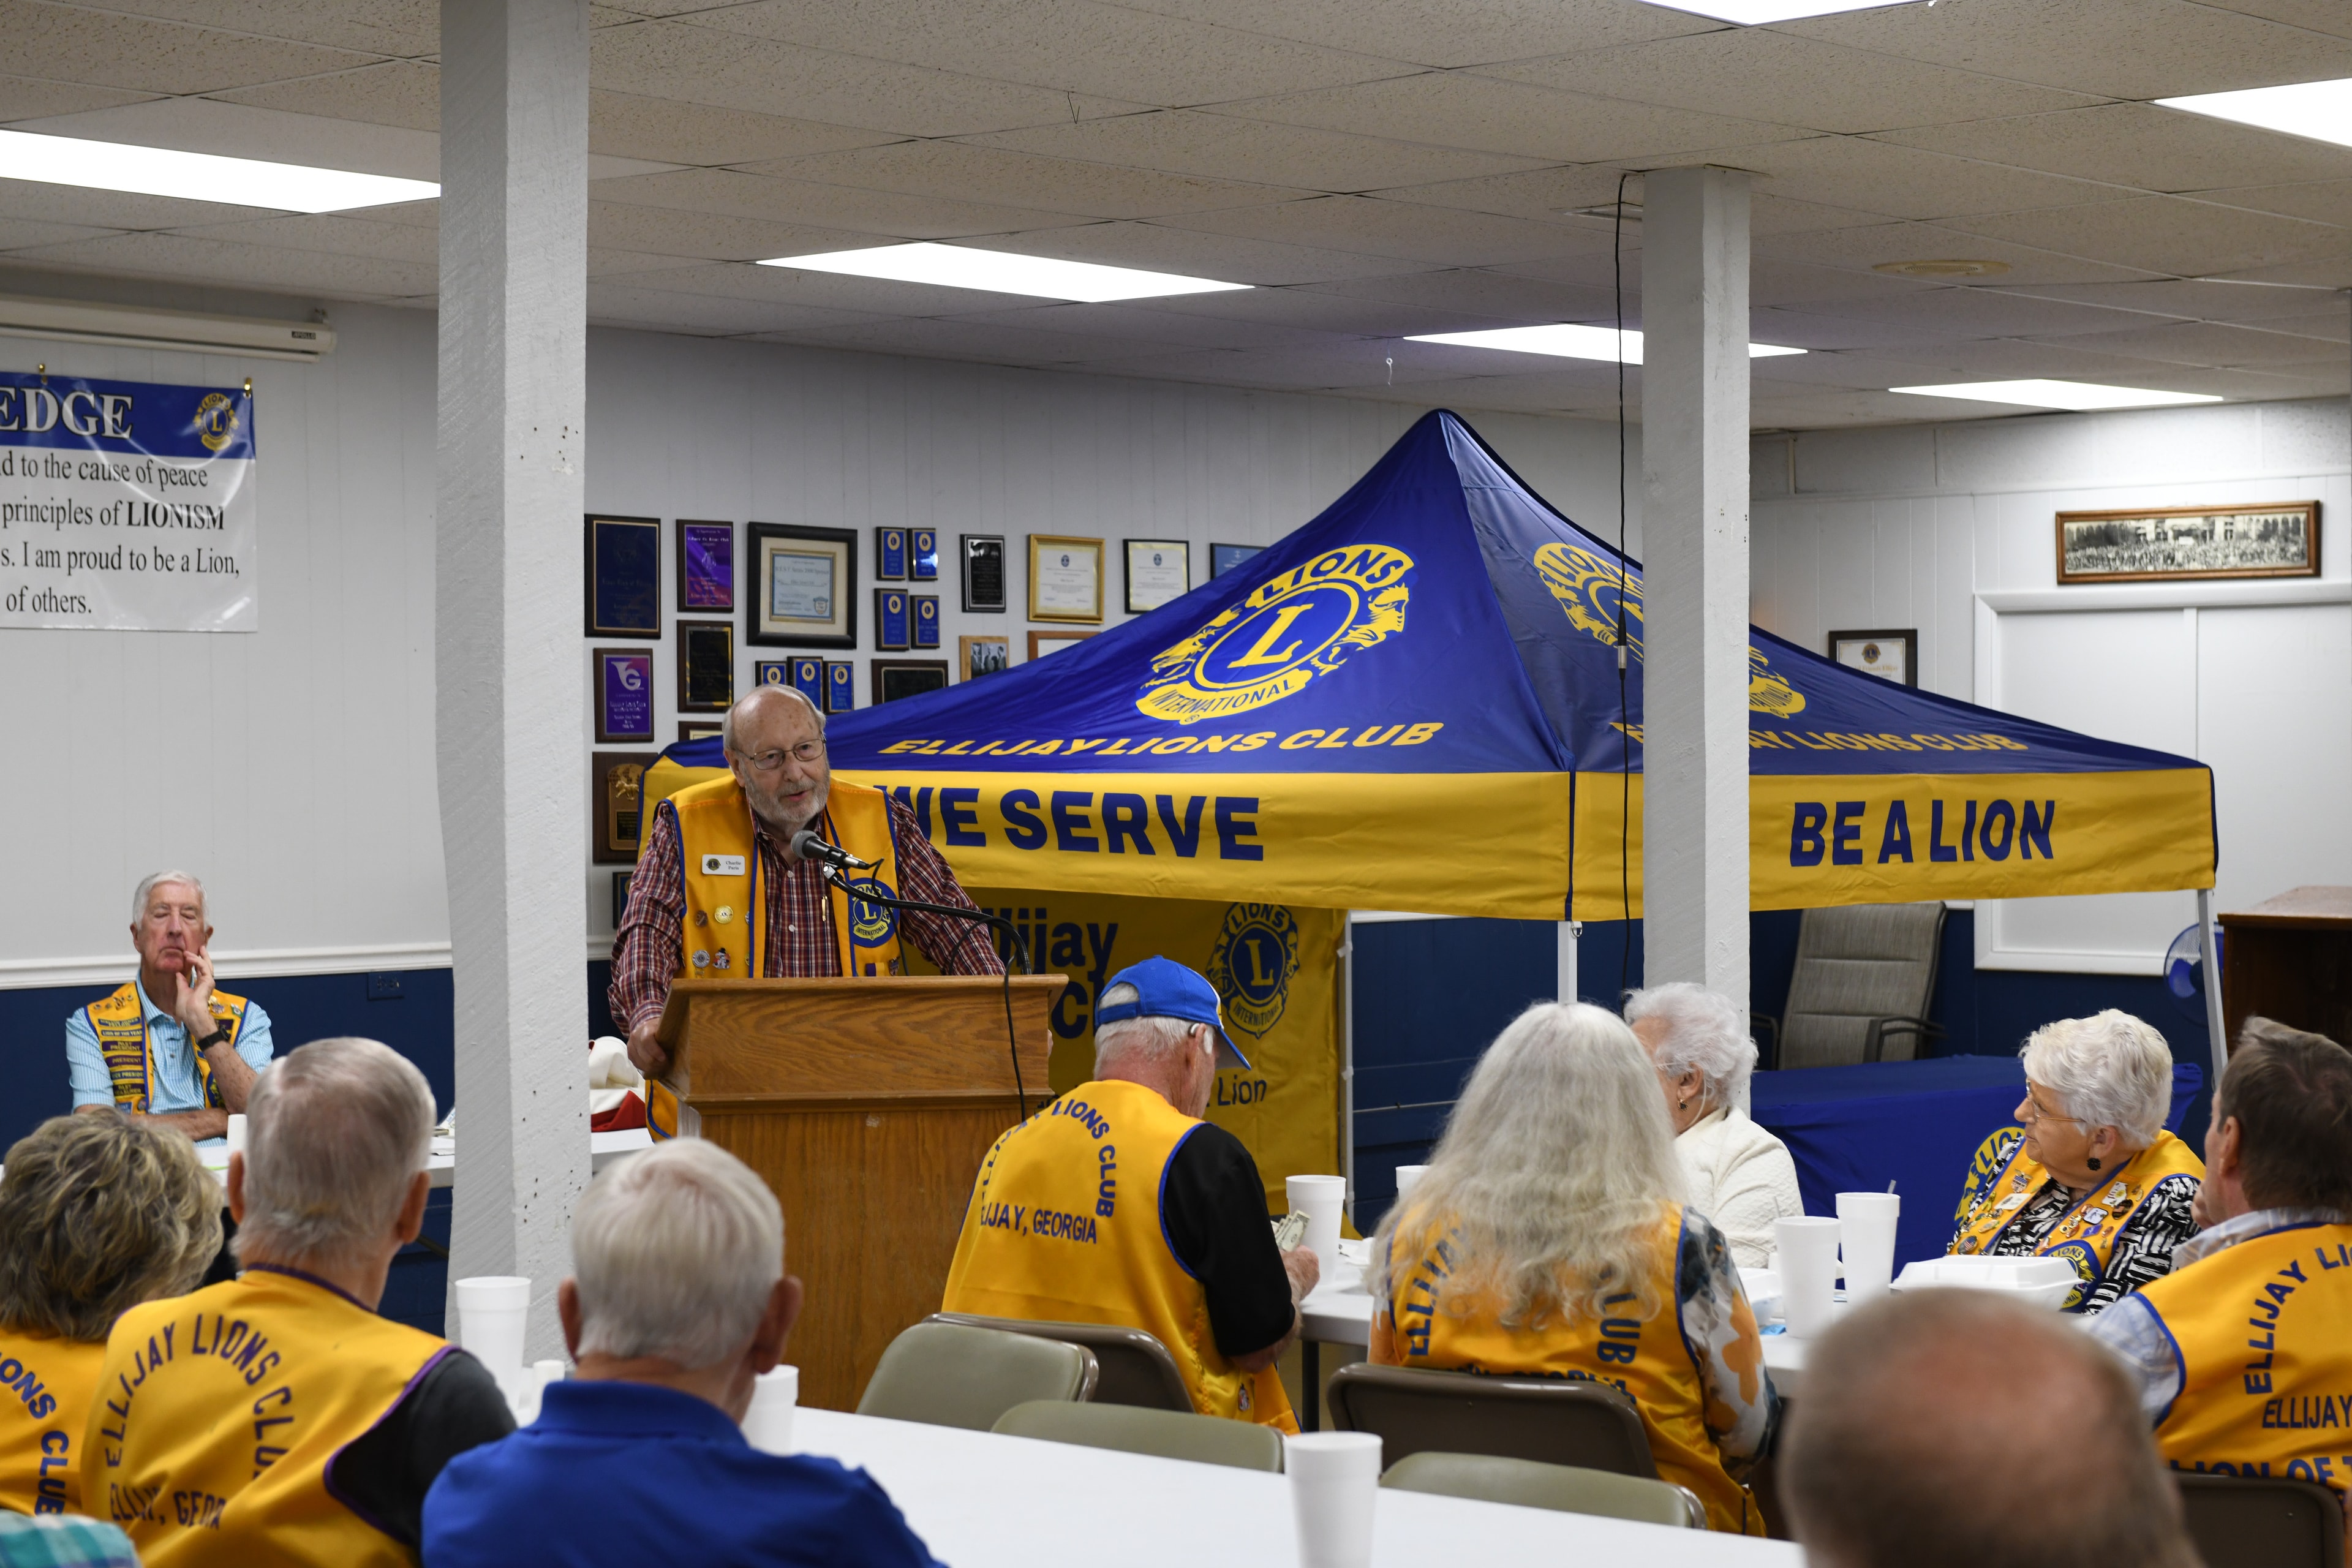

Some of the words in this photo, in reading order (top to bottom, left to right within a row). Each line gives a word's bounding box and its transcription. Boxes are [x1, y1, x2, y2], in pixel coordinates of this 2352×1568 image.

[21, 454, 39, 478] to
[44, 453, 72, 479] the
[78, 460, 130, 481] cause
[137, 458, 154, 483] of
[159, 467, 209, 491] peace
[2, 496, 93, 531] principles
[100, 499, 123, 526] of
[126, 501, 224, 530] LIONISM
[22, 541, 29, 568] I
[35, 549, 62, 569] am
[67, 545, 123, 576] proud
[129, 549, 147, 571] to
[154, 545, 176, 572] be
[181, 553, 190, 573] a
[195, 547, 241, 578] Lion,
[1262, 548, 1405, 601] LIONS
[6, 586, 29, 612] of
[31, 586, 92, 614] others.
[1227, 604, 1315, 669] L
[1149, 679, 1295, 714] INTERNATIONAL
[877, 738, 1107, 756] ELLIJAY
[1094, 731, 1278, 755] LIONS
[1279, 722, 1445, 750] CLUB
[1782, 731, 1924, 752] LIONS
[1910, 734, 2029, 751] CLUB
[873, 785, 986, 847] WE
[1000, 788, 1264, 861] SERVE
[1790, 801, 1866, 868] BE
[1878, 799, 1914, 865] A
[1929, 799, 2056, 862] LION
[860, 901, 877, 921] L
[1231, 902, 1285, 929] LIONS
[1245, 939, 1274, 986] L
[1234, 1001, 1280, 1026] INTERNATIONAL
[1218, 1074, 1267, 1106] Lion
[1051, 1099, 1110, 1140] LIONS
[1095, 1144, 1117, 1218] CLUB
[1033, 1208, 1097, 1245] GEORGIA
[2243, 1259, 2308, 1395] ELLIJAY
[2314, 1243, 2352, 1270] LI
[101, 1321, 176, 1468] ELLIJAY
[192, 1313, 281, 1386] LIONS
[253, 1386, 295, 1481] CLU
[2262, 1394, 2352, 1429] ELLIJAY
